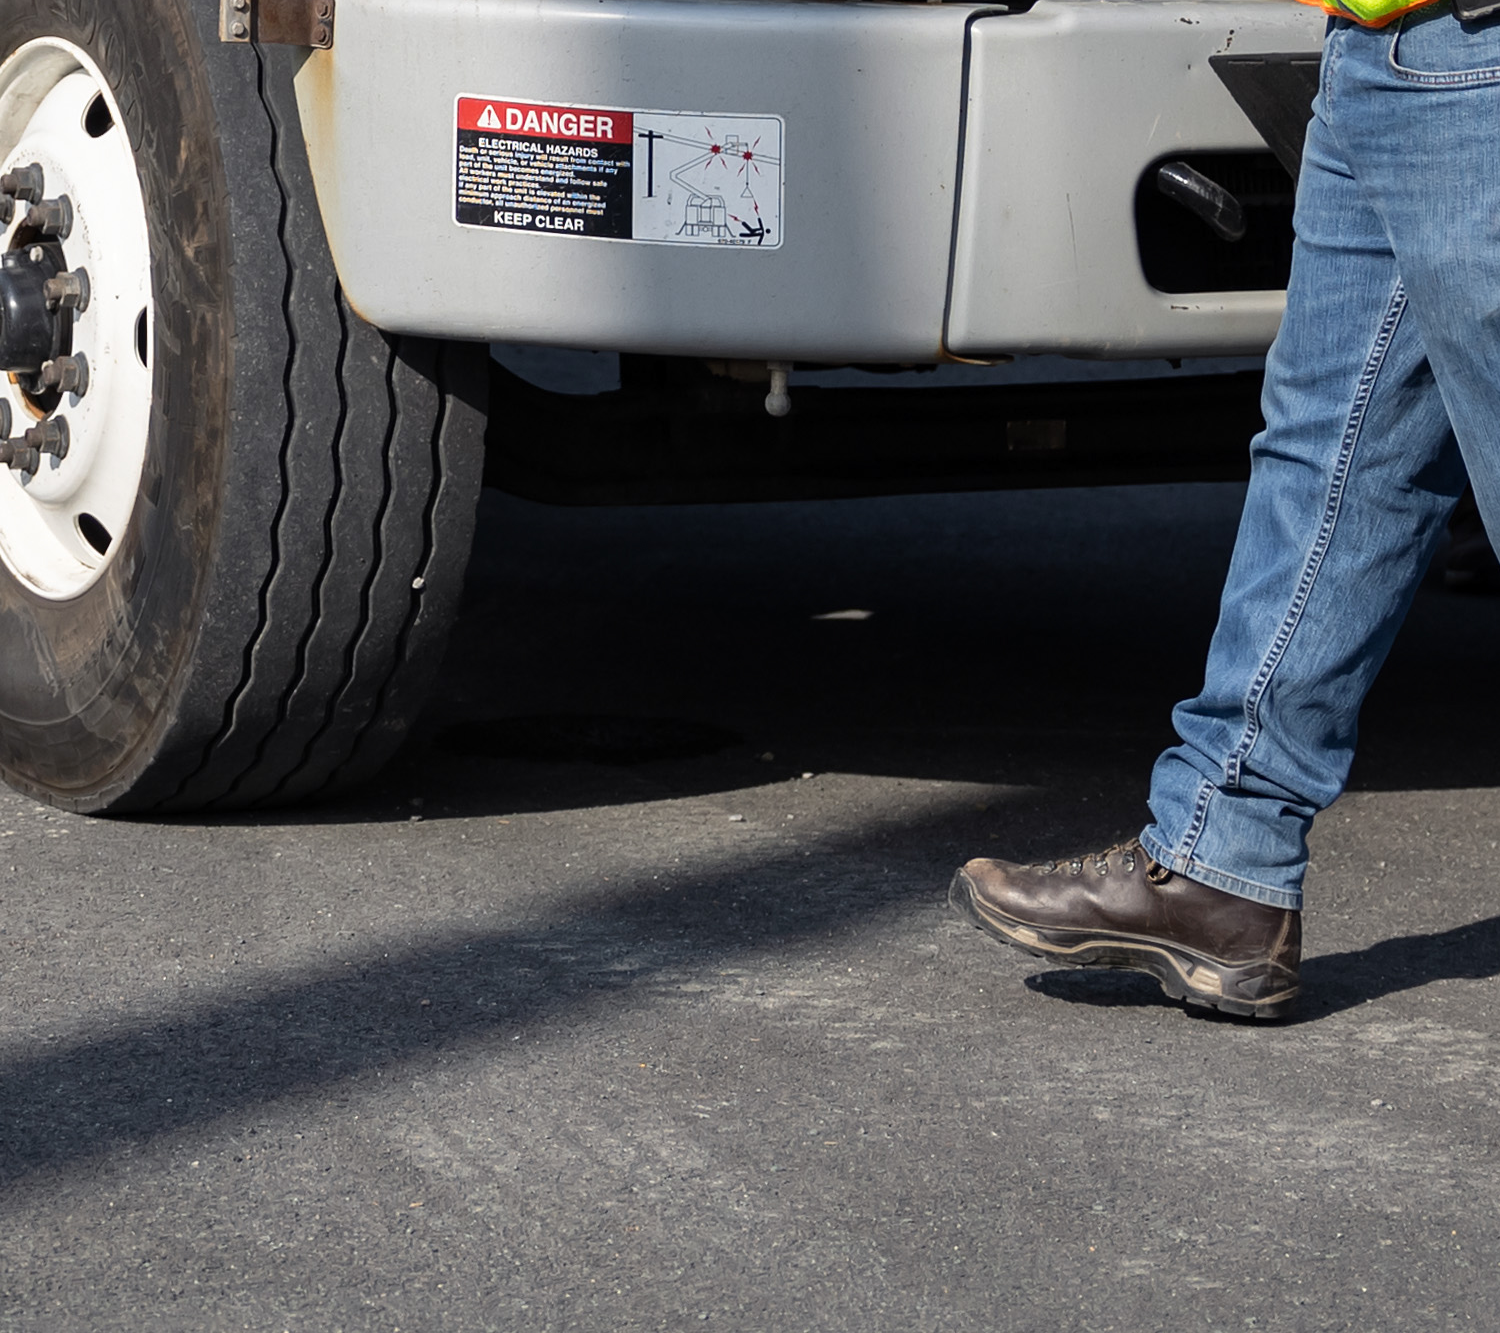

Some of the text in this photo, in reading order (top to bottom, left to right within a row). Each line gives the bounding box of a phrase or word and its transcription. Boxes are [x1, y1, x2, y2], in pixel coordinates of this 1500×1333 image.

[505, 108, 612, 138] DANGER
[478, 137, 598, 158] ELECTRICAL HAZARDS
[493, 210, 584, 231] KEEP CLEAR
